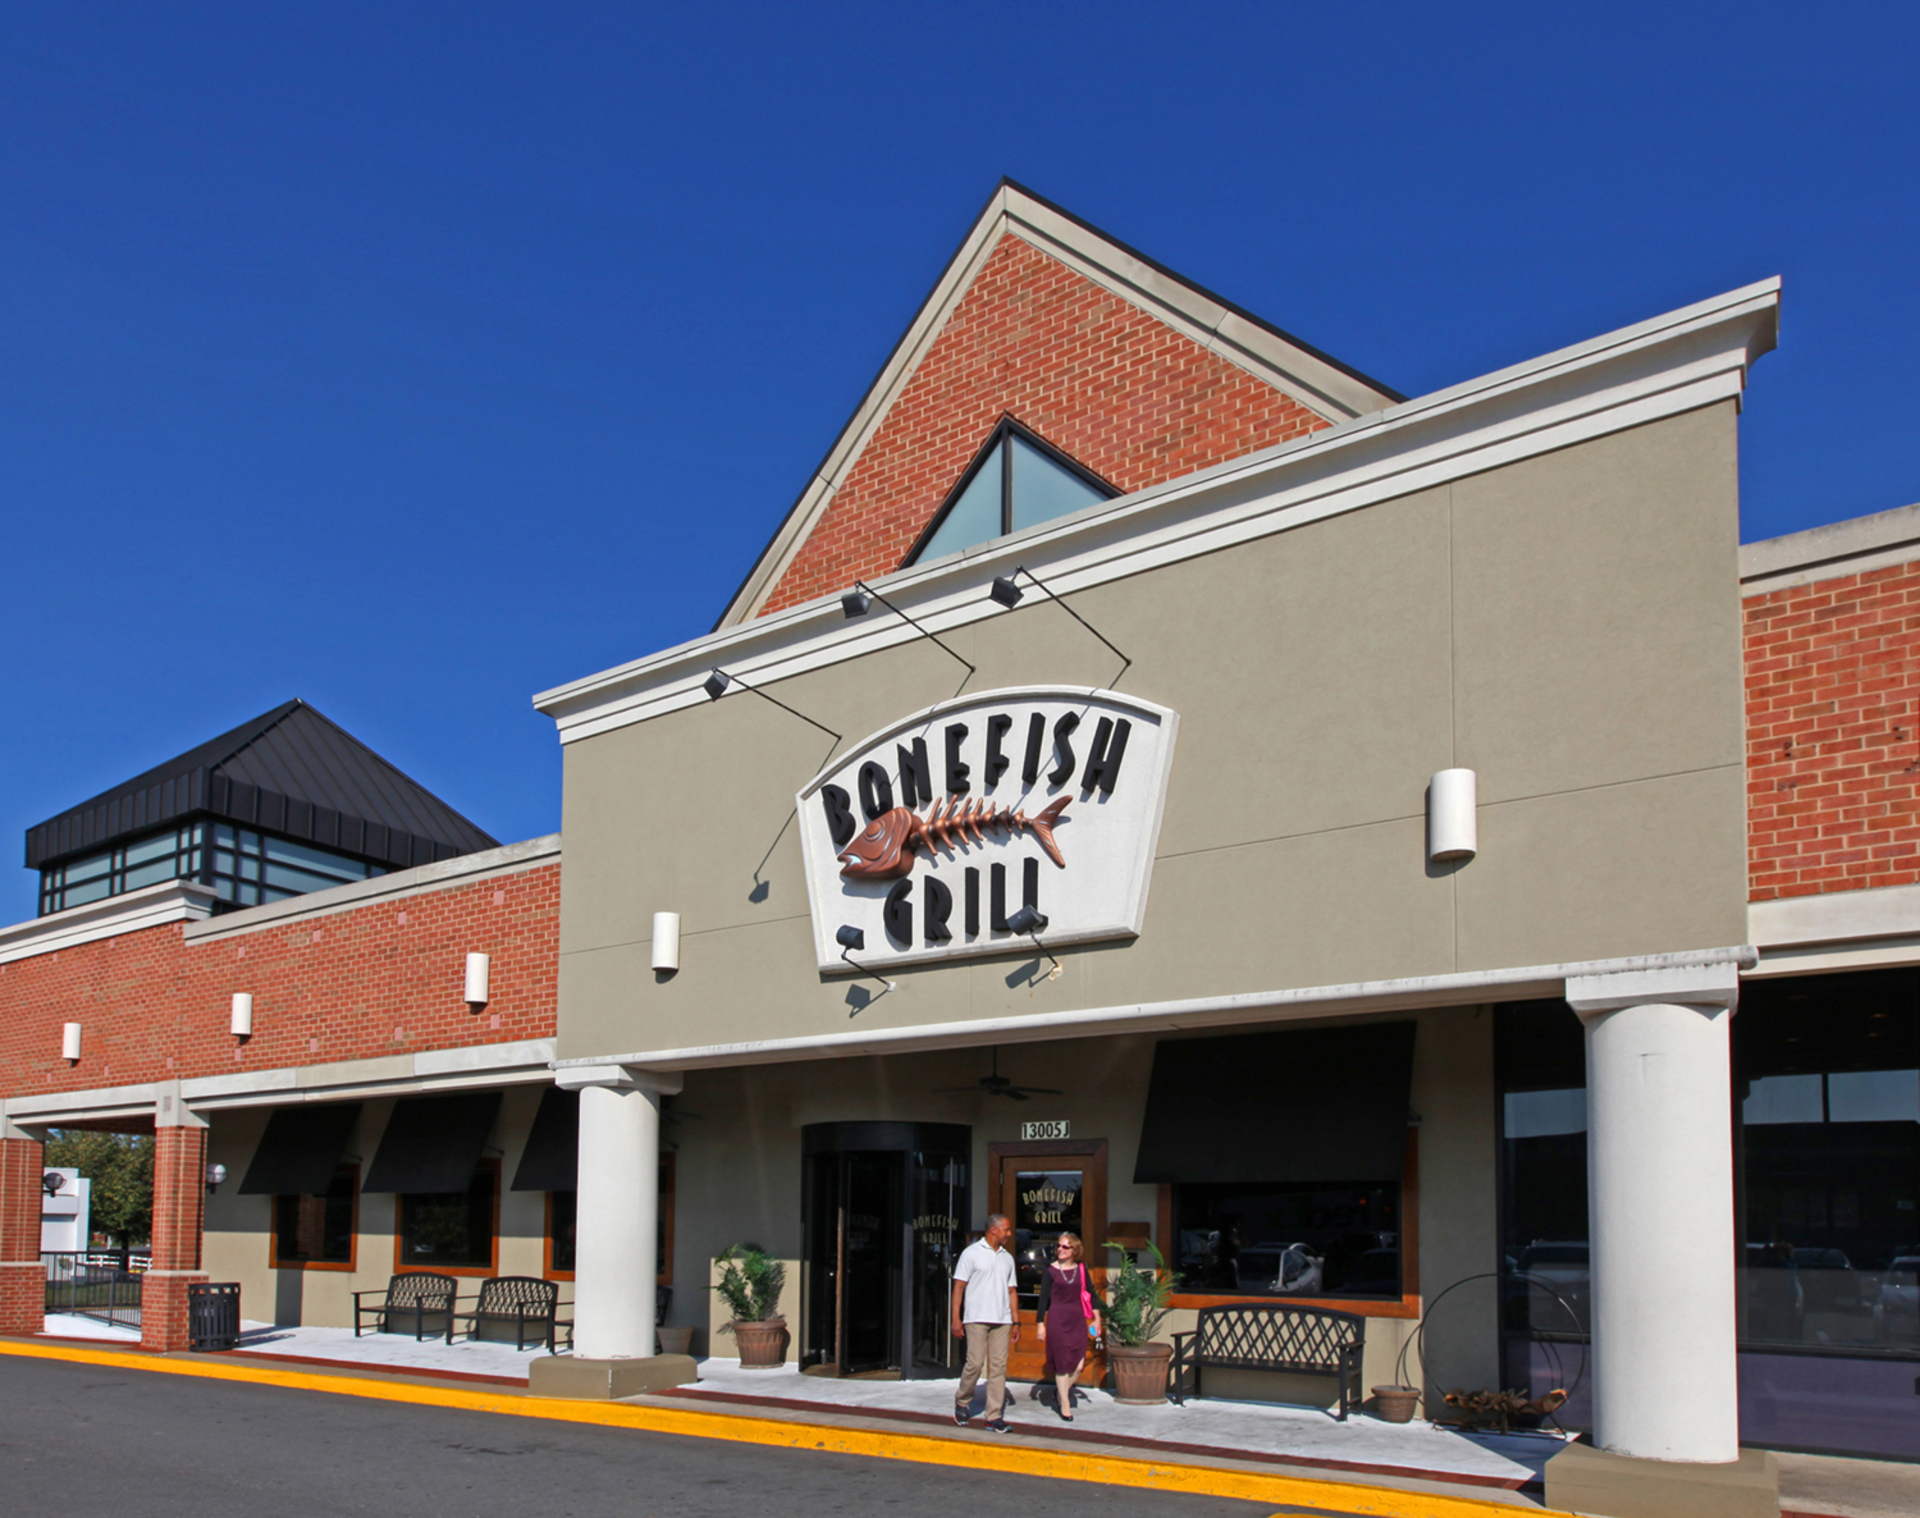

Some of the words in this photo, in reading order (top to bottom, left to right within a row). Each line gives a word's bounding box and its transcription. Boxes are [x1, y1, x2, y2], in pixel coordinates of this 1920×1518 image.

[821, 711, 1132, 846] BONEFISH
[883, 856, 1049, 946] GRILL
[1023, 1121, 1070, 1139] 13005J
[1022, 1188, 1075, 1206] BONEFISH
[1034, 1211, 1062, 1224] GRILL
[922, 1231, 948, 1245] GRILL
